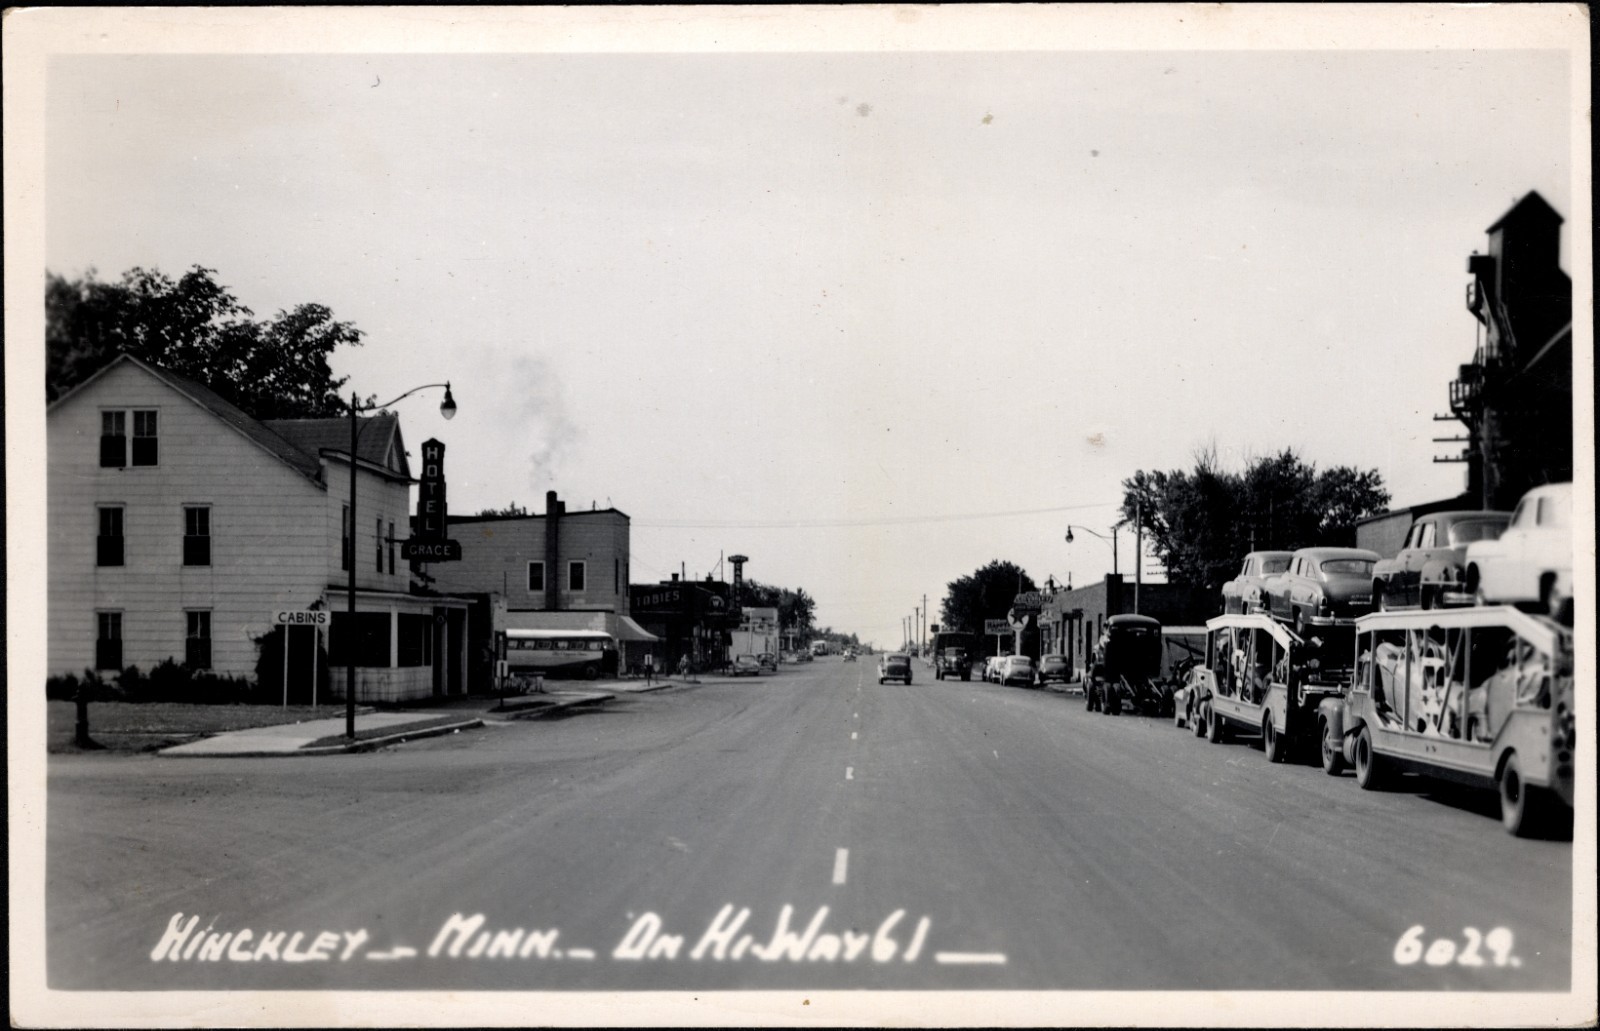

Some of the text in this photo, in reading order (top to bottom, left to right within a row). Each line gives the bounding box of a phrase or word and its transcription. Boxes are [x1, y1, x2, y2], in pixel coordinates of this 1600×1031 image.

[425, 446, 438, 531] HOTEL
[409, 545, 451, 556] GRACE
[278, 611, 326, 624] CABINS
